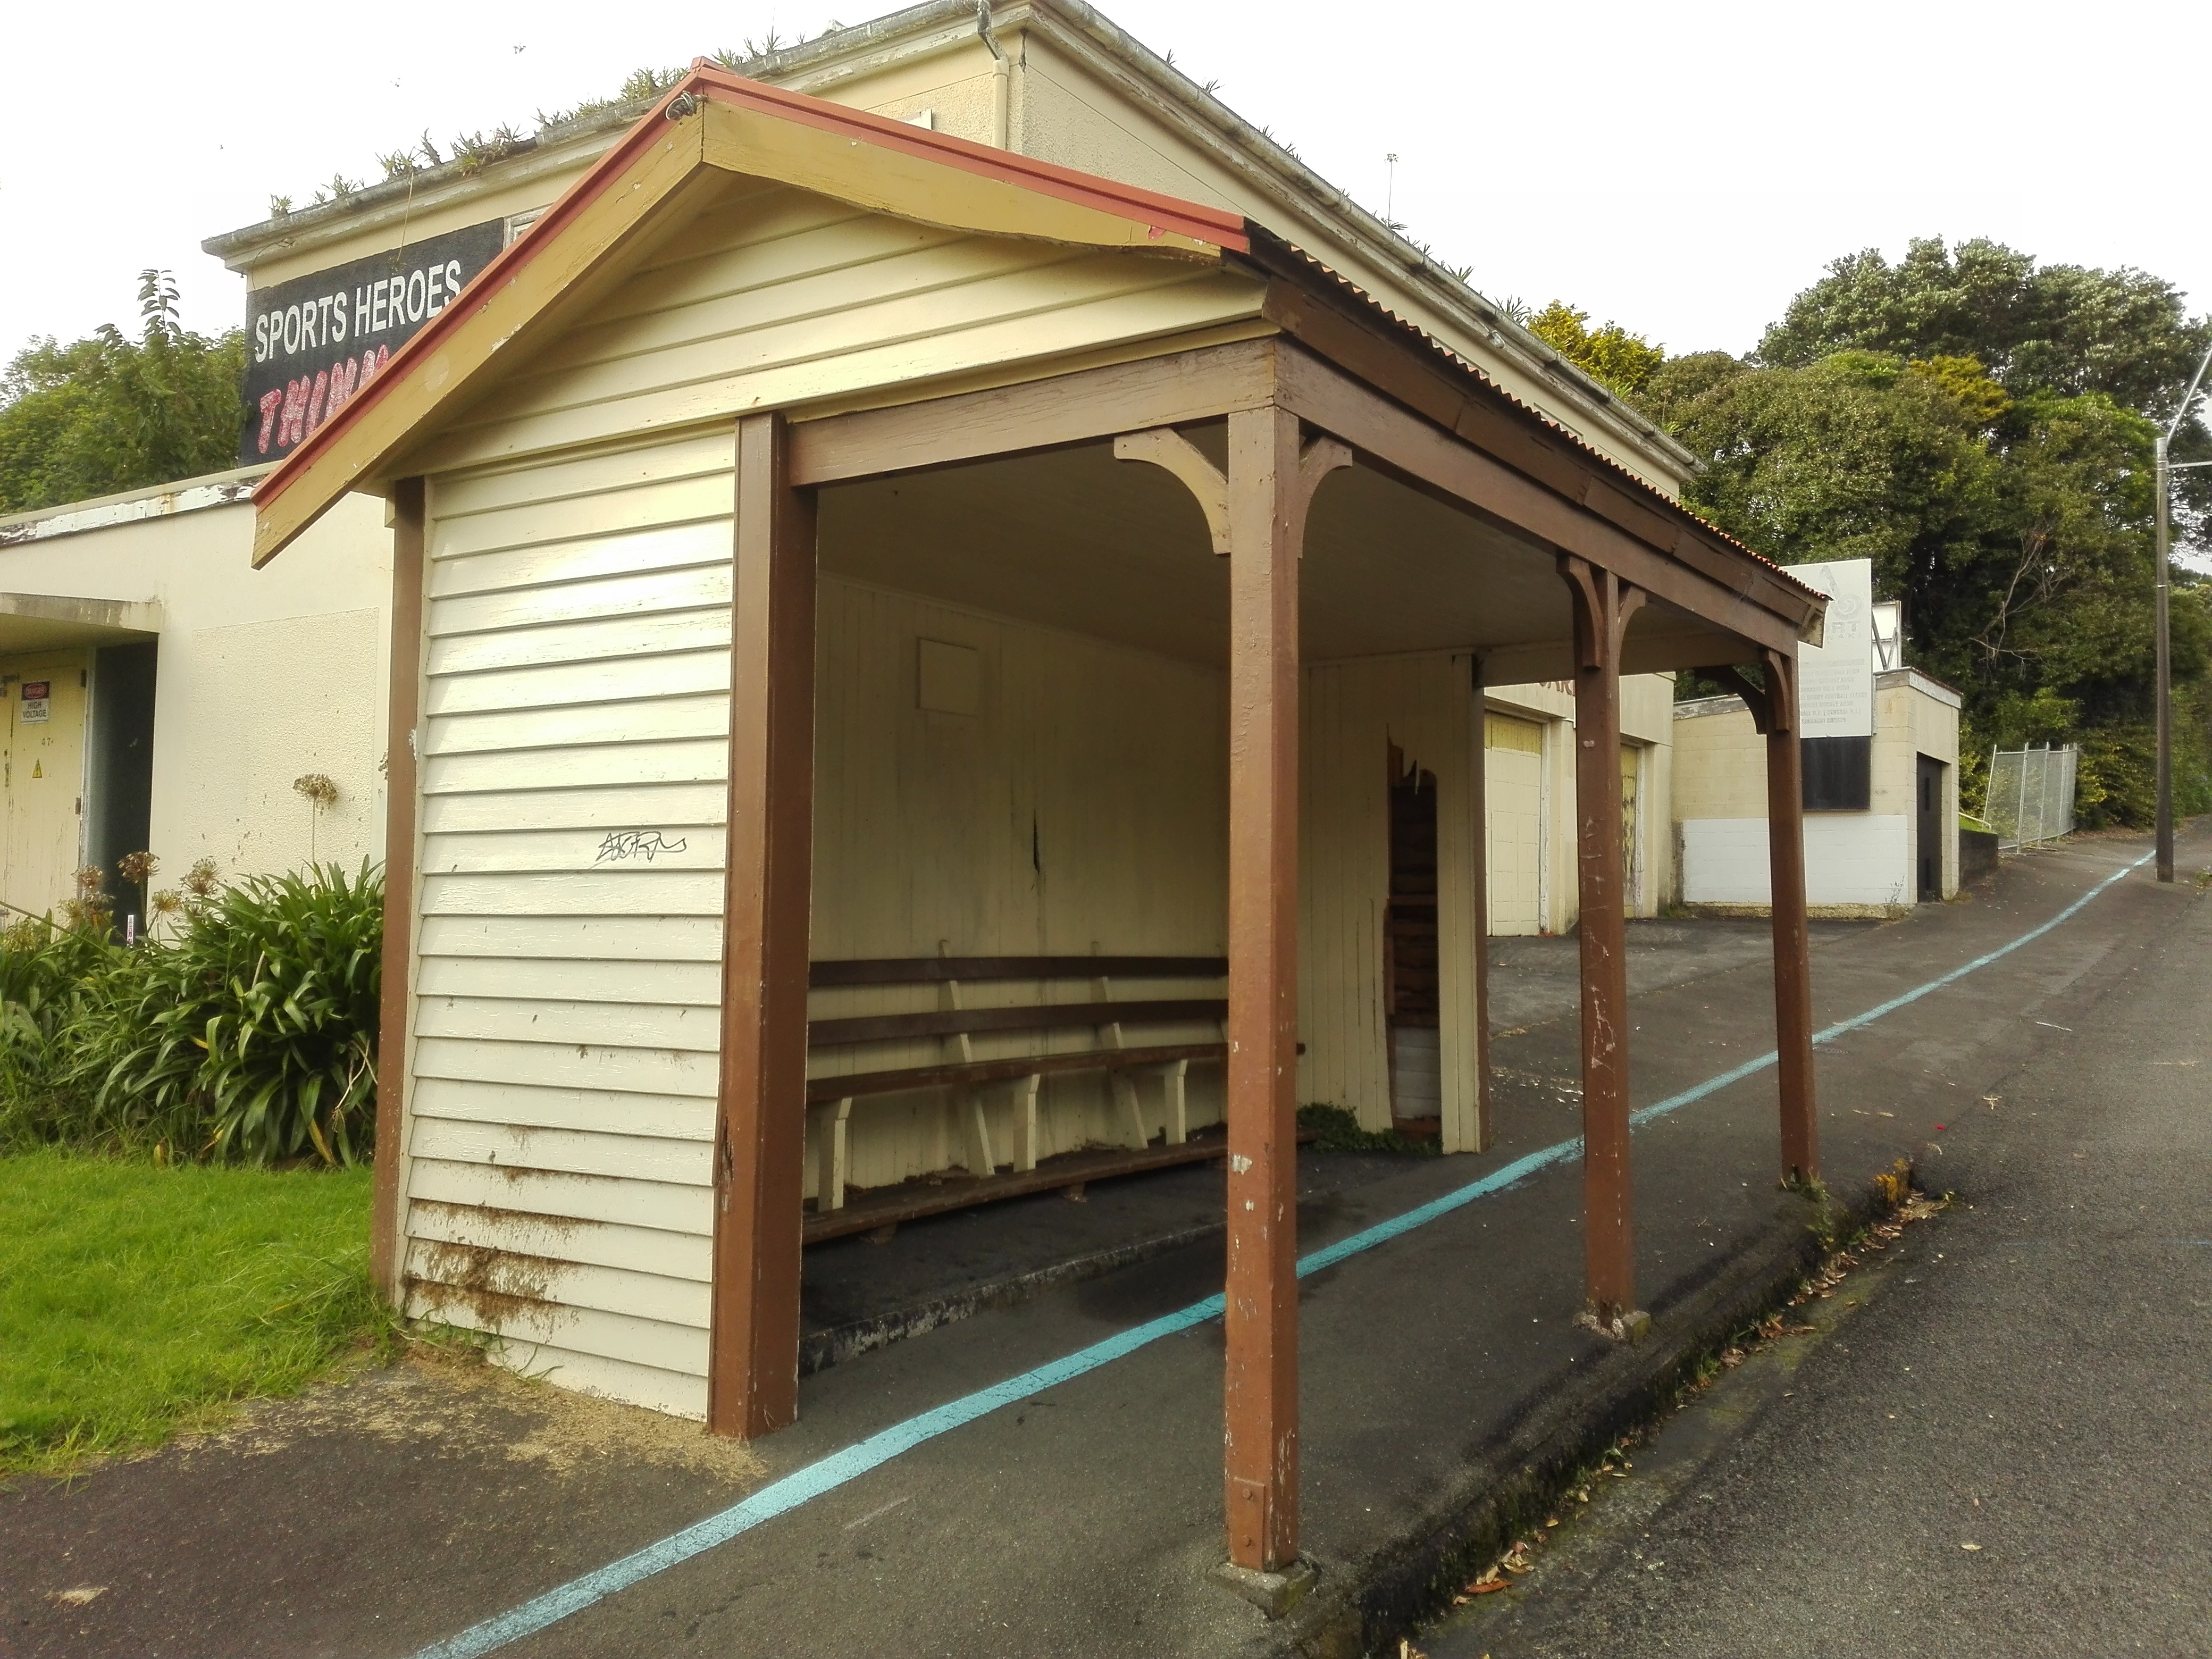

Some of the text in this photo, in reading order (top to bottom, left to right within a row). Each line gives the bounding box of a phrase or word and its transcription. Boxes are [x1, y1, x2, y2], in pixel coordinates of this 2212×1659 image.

[255, 259, 461, 363] SPORTS HEROES
[22, 709, 46, 718] VOLTAGE
